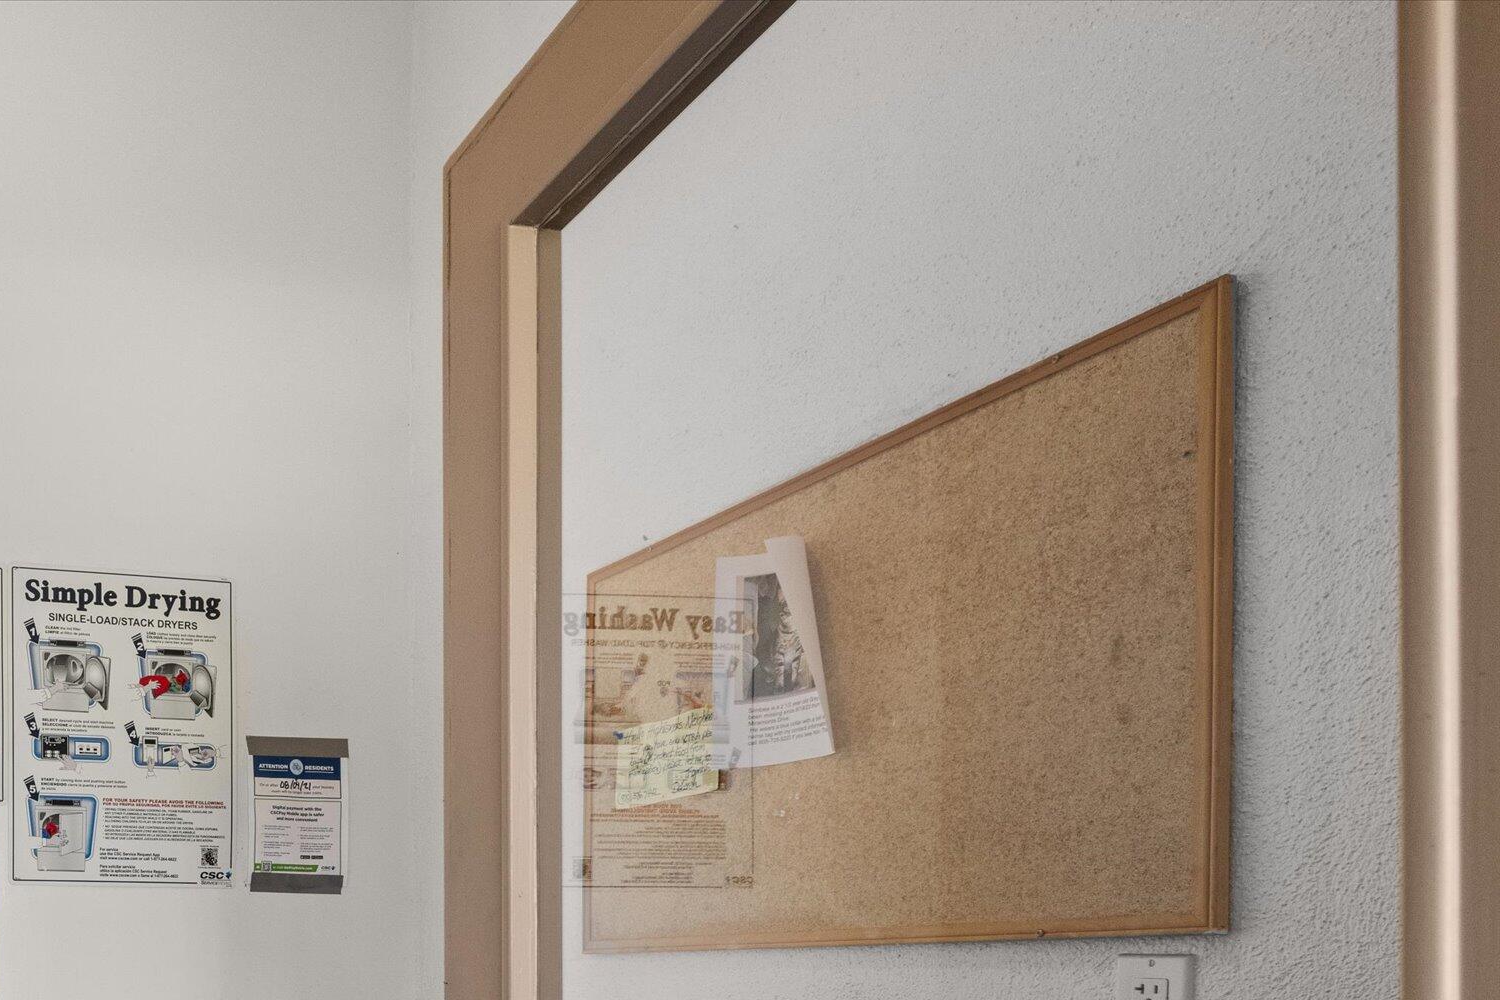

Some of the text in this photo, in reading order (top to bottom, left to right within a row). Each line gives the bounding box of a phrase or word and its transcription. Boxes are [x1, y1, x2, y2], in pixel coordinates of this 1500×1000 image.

[25, 579, 221, 620] Simple Drying
[48, 612, 198, 630] SINGLE-LOAD/STACK DRYERS
[30, 628, 35, 636] 1
[30, 722, 37, 731] 3
[29, 785, 36, 794] 5
[200, 871, 225, 879] CSC
